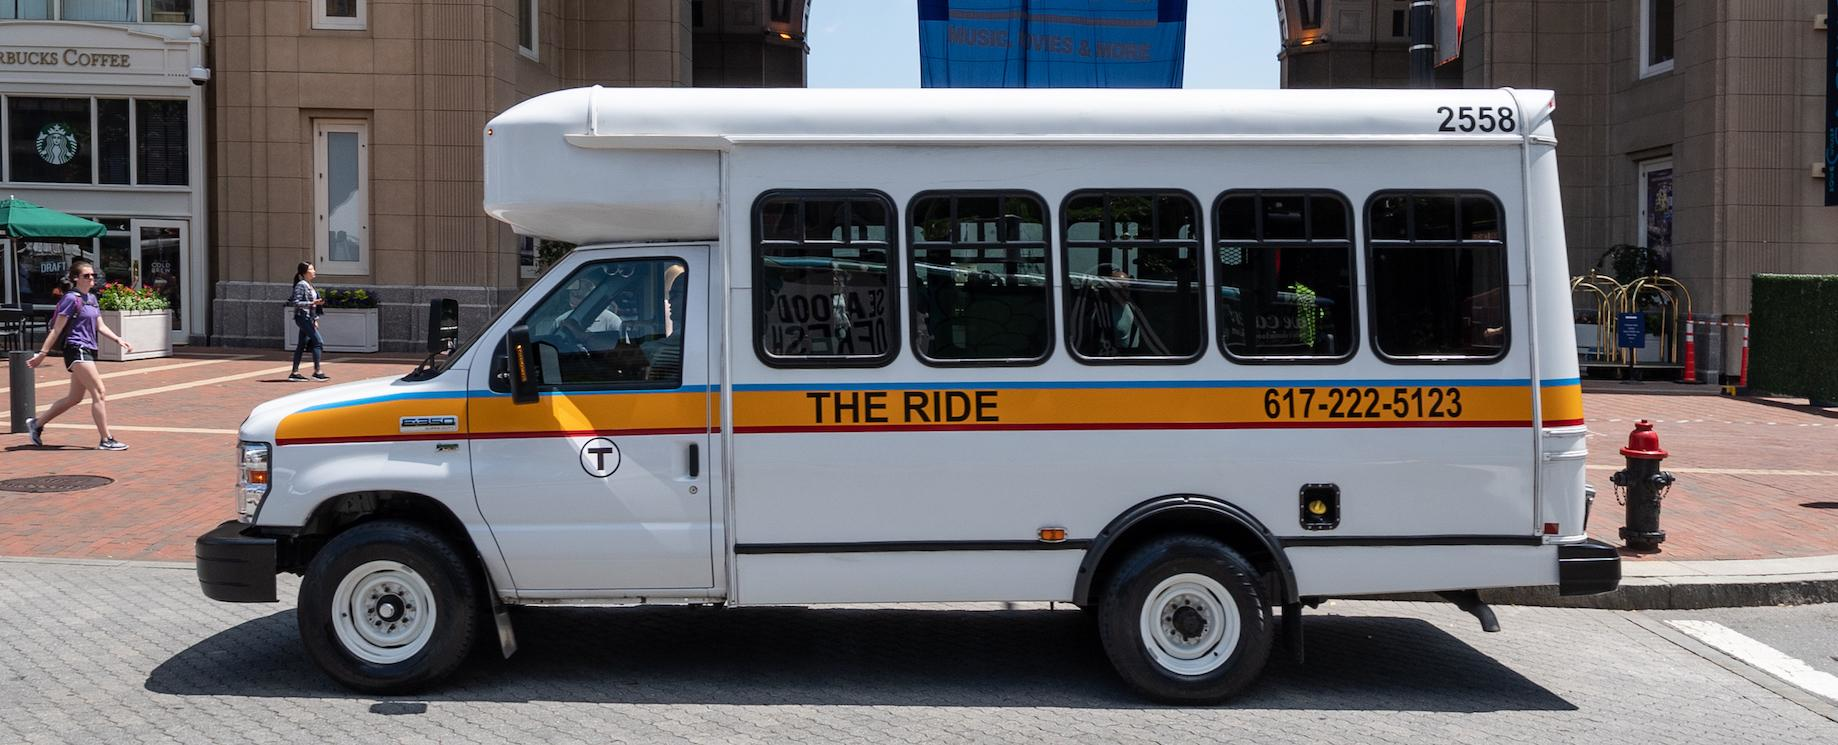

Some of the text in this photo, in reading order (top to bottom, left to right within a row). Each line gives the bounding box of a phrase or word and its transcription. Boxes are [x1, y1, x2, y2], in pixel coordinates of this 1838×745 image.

[1014, 29, 1073, 55] OVIES
[1078, 38, 1091, 57] &
[1096, 41, 1152, 60] MORE
[1437, 106, 1516, 133] 2558
[41, 261, 66, 273] DRAFT
[806, 391, 999, 424] THE RIDE
[1263, 387, 1463, 420] 617-222-5123
[587, 448, 613, 470] T
